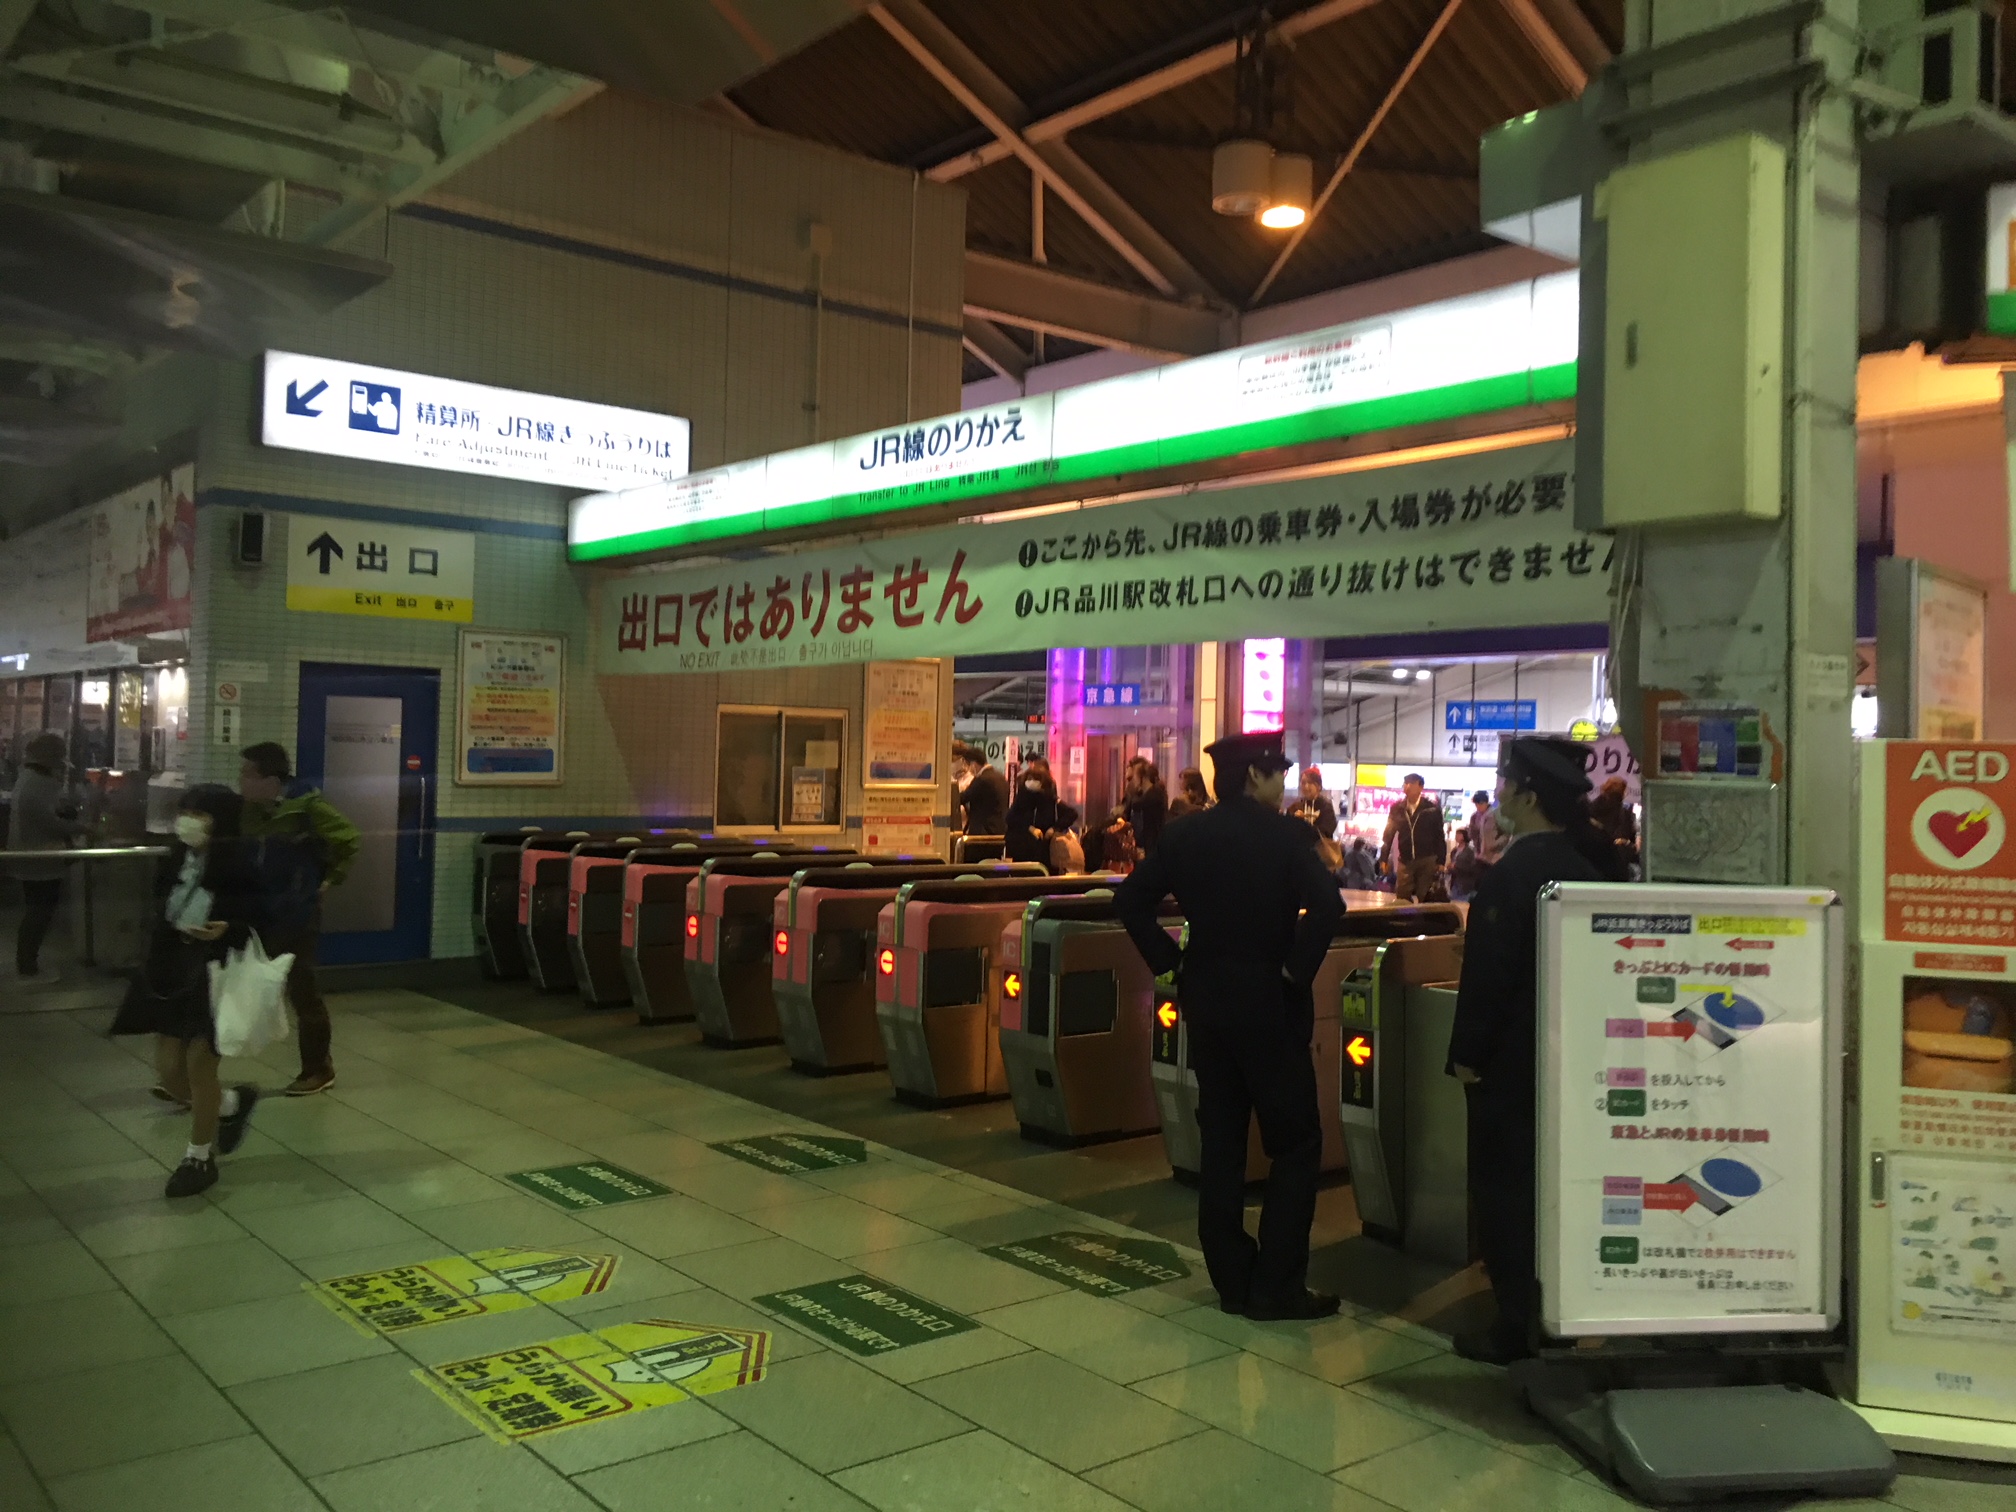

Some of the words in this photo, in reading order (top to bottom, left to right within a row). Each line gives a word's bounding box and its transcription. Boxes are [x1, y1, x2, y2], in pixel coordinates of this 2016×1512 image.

[859, 407, 1026, 470] JR線のりかえ
[859, 488, 895, 503] Transfer
[900, 486, 908, 497] to
[912, 482, 925, 493] JR
[929, 478, 950, 491] Line
[1040, 470, 1577, 564] ここから先、JR線の乗車券・入場券が必要
[356, 541, 438, 577] 出口
[355, 592, 382, 607] Exit
[618, 548, 983, 652] 出口ではありません
[679, 653, 696, 669] NO
[698, 650, 721, 669] EXIT
[799, 642, 827, 661] 출구가
[1910, 749, 2010, 782] AED
[837, 1281, 955, 1332] JR線のりかえ口
